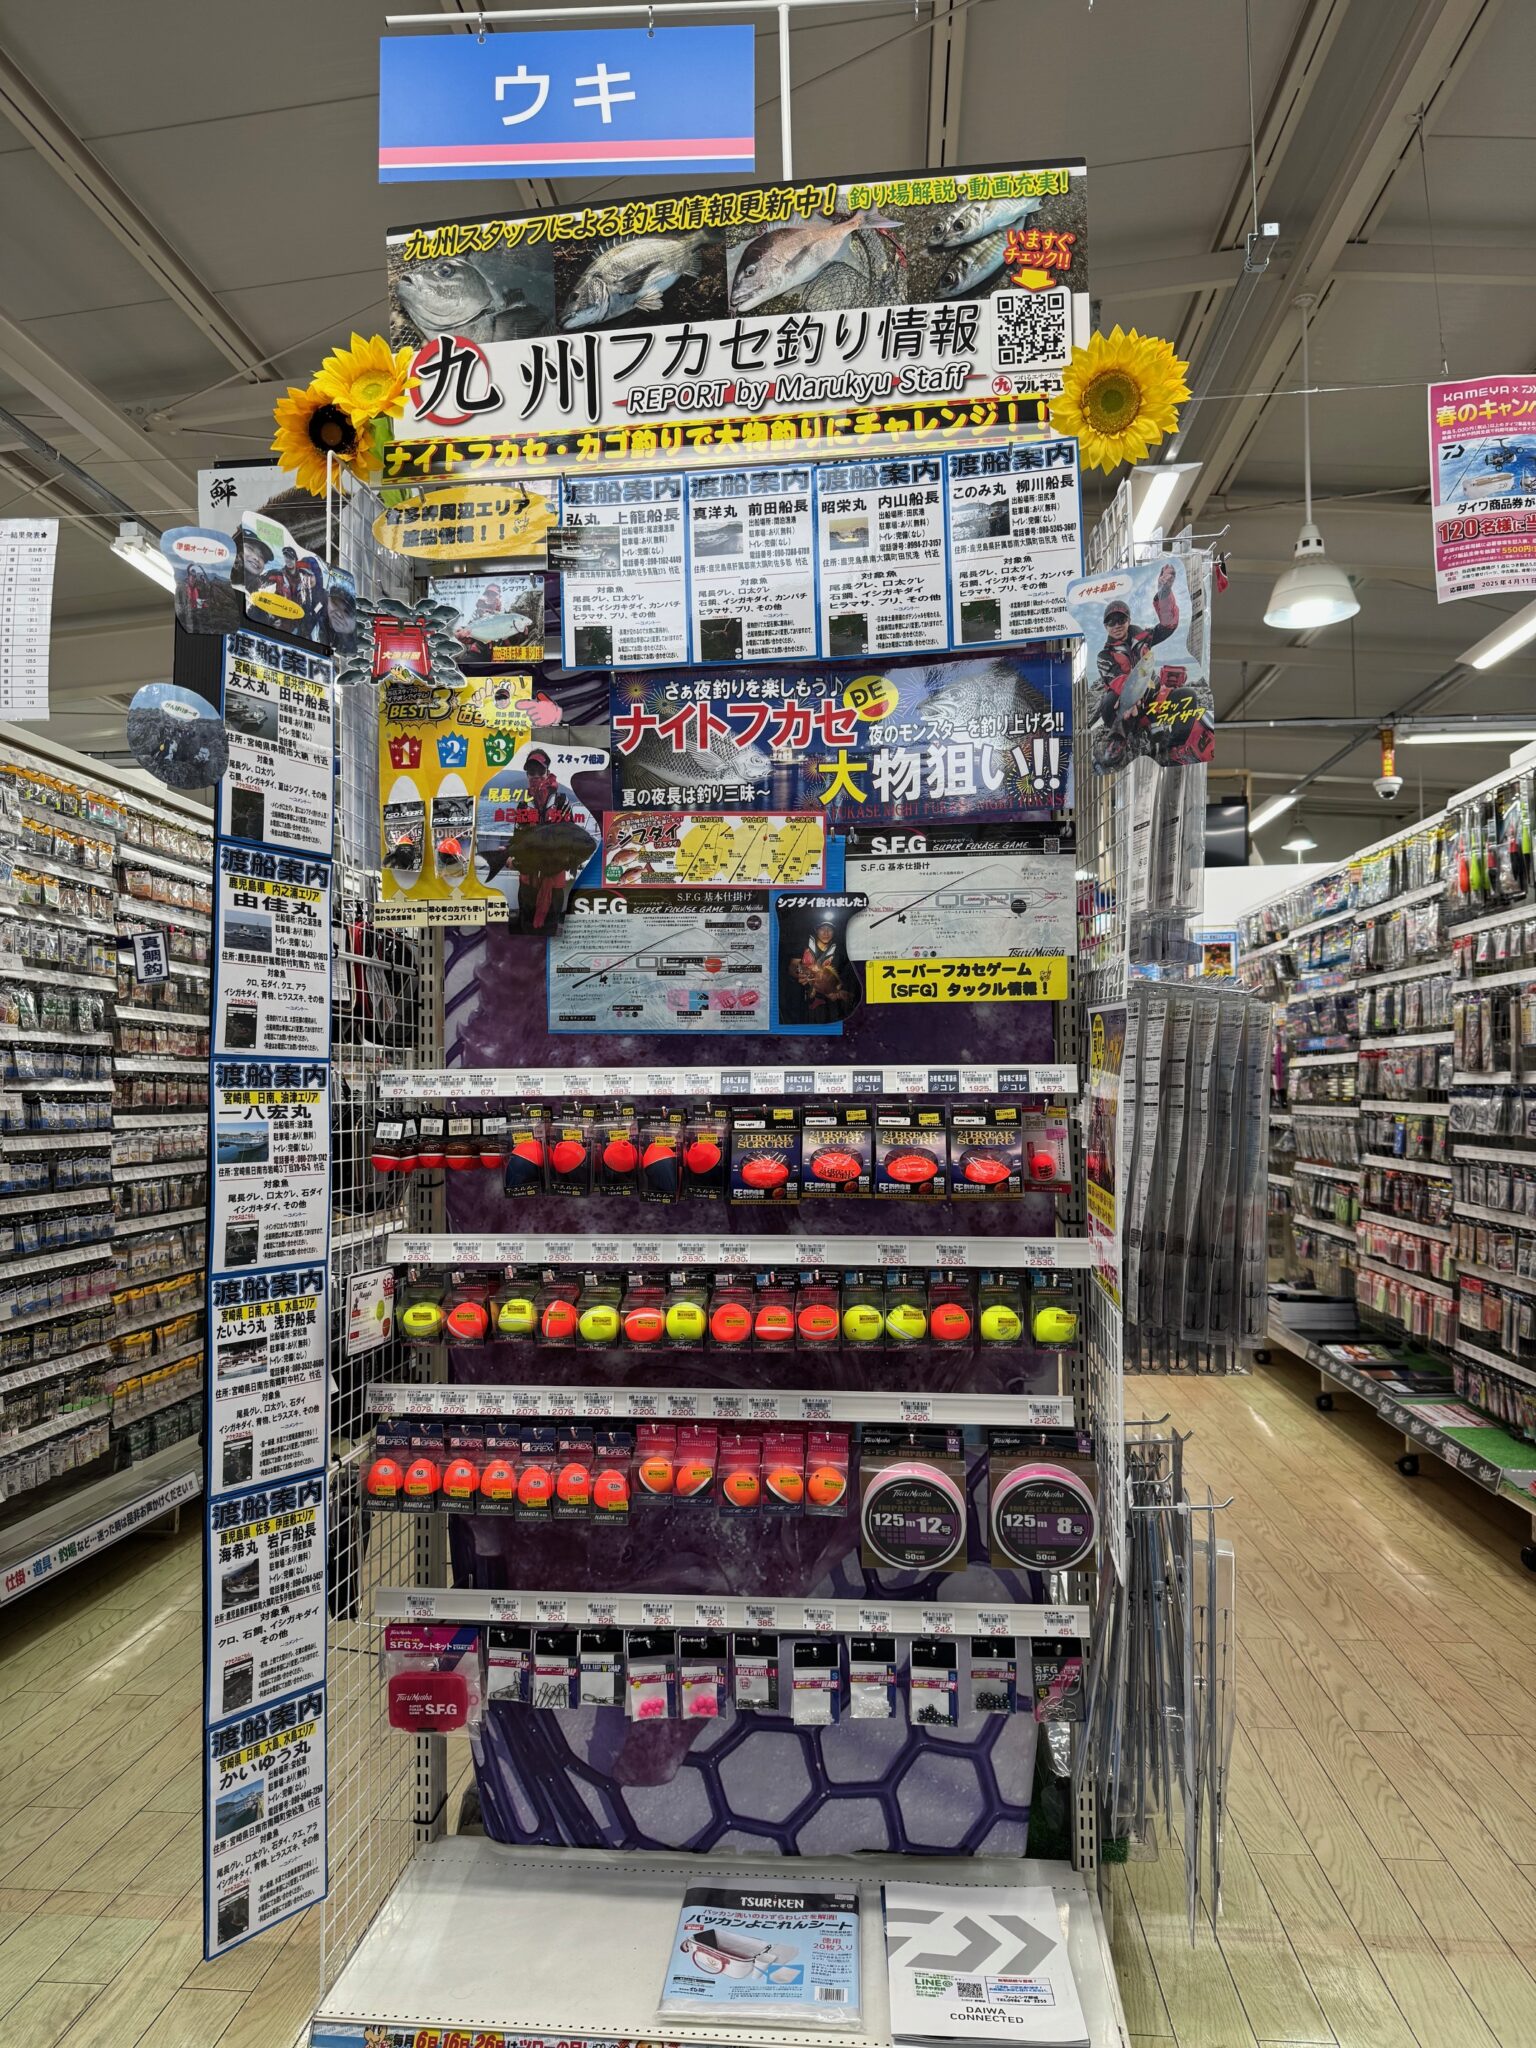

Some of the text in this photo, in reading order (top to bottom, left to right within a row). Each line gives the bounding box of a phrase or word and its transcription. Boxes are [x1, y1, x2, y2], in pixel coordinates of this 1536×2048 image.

[494, 62, 636, 125] ウキ
[1006, 230, 1076, 251] いますぐ
[626, 362, 970, 415] REPORT by Marukyu Staff
[1443, 386, 1509, 401] KAMEYA
[1435, 398, 1536, 427] 春のキャン
[950, 443, 1076, 478] 渡船案内
[689, 468, 810, 498] 渡船案内
[818, 460, 941, 492] 渡船案内
[953, 482, 1007, 500] このみ丸
[748, 499, 809, 516] 前田船長
[821, 491, 940, 515] 昭栄丸 内山船長
[1003, 556, 1033, 565] 対象魚
[861, 570, 898, 579] 対象魚
[228, 671, 330, 714] 友太丸 田中船長
[1147, 697, 1192, 715] スタッフ
[613, 699, 858, 753] ナイトフカセ
[488, 788, 534, 803] 尾長グレ
[871, 836, 927, 855] S.F.G
[933, 841, 1029, 852] SUPER FUKASE GAME
[221, 846, 329, 889] 渡船案内
[888, 861, 930, 872] 基本仕掛け
[233, 893, 318, 918] 由佳丸
[677, 892, 753, 902] S.F.G 基本仕掛け
[574, 898, 628, 915] S.F.G
[633, 906, 660, 914] SUPER
[699, 905, 725, 913] GAME
[882, 961, 1032, 979] スーパーフカセゲーム
[215, 1063, 328, 1089] 渡船案内
[224, 1092, 251, 1104] 宮崎県
[263, 1179, 289, 1189] 対象魚
[213, 1268, 324, 1308] 渡船案内
[216, 1310, 317, 1340] たいよう丸 浅野船長
[211, 1480, 323, 1531] 渡船案内
[267, 1522, 317, 1550] 岩戸船長
[905, 1552, 926, 1561] 50cm
[1036, 1552, 1057, 1561] 50cm
[260, 1605, 290, 1622] 対象魚
[260, 1629, 289, 1645] その他
[1034, 1666, 1058, 1674] SFG
[425, 1704, 457, 1716] S.F.G
[211, 1692, 323, 1759] 渡船案内
[219, 1741, 312, 1792] かいゆう丸
[740, 1896, 804, 1909] TSURIKEN
[686, 1914, 853, 1931] バッカンよごれんシート
[950, 2013, 1024, 2024] CONNECTED
[966, 2006, 1007, 2016] DAIWA
